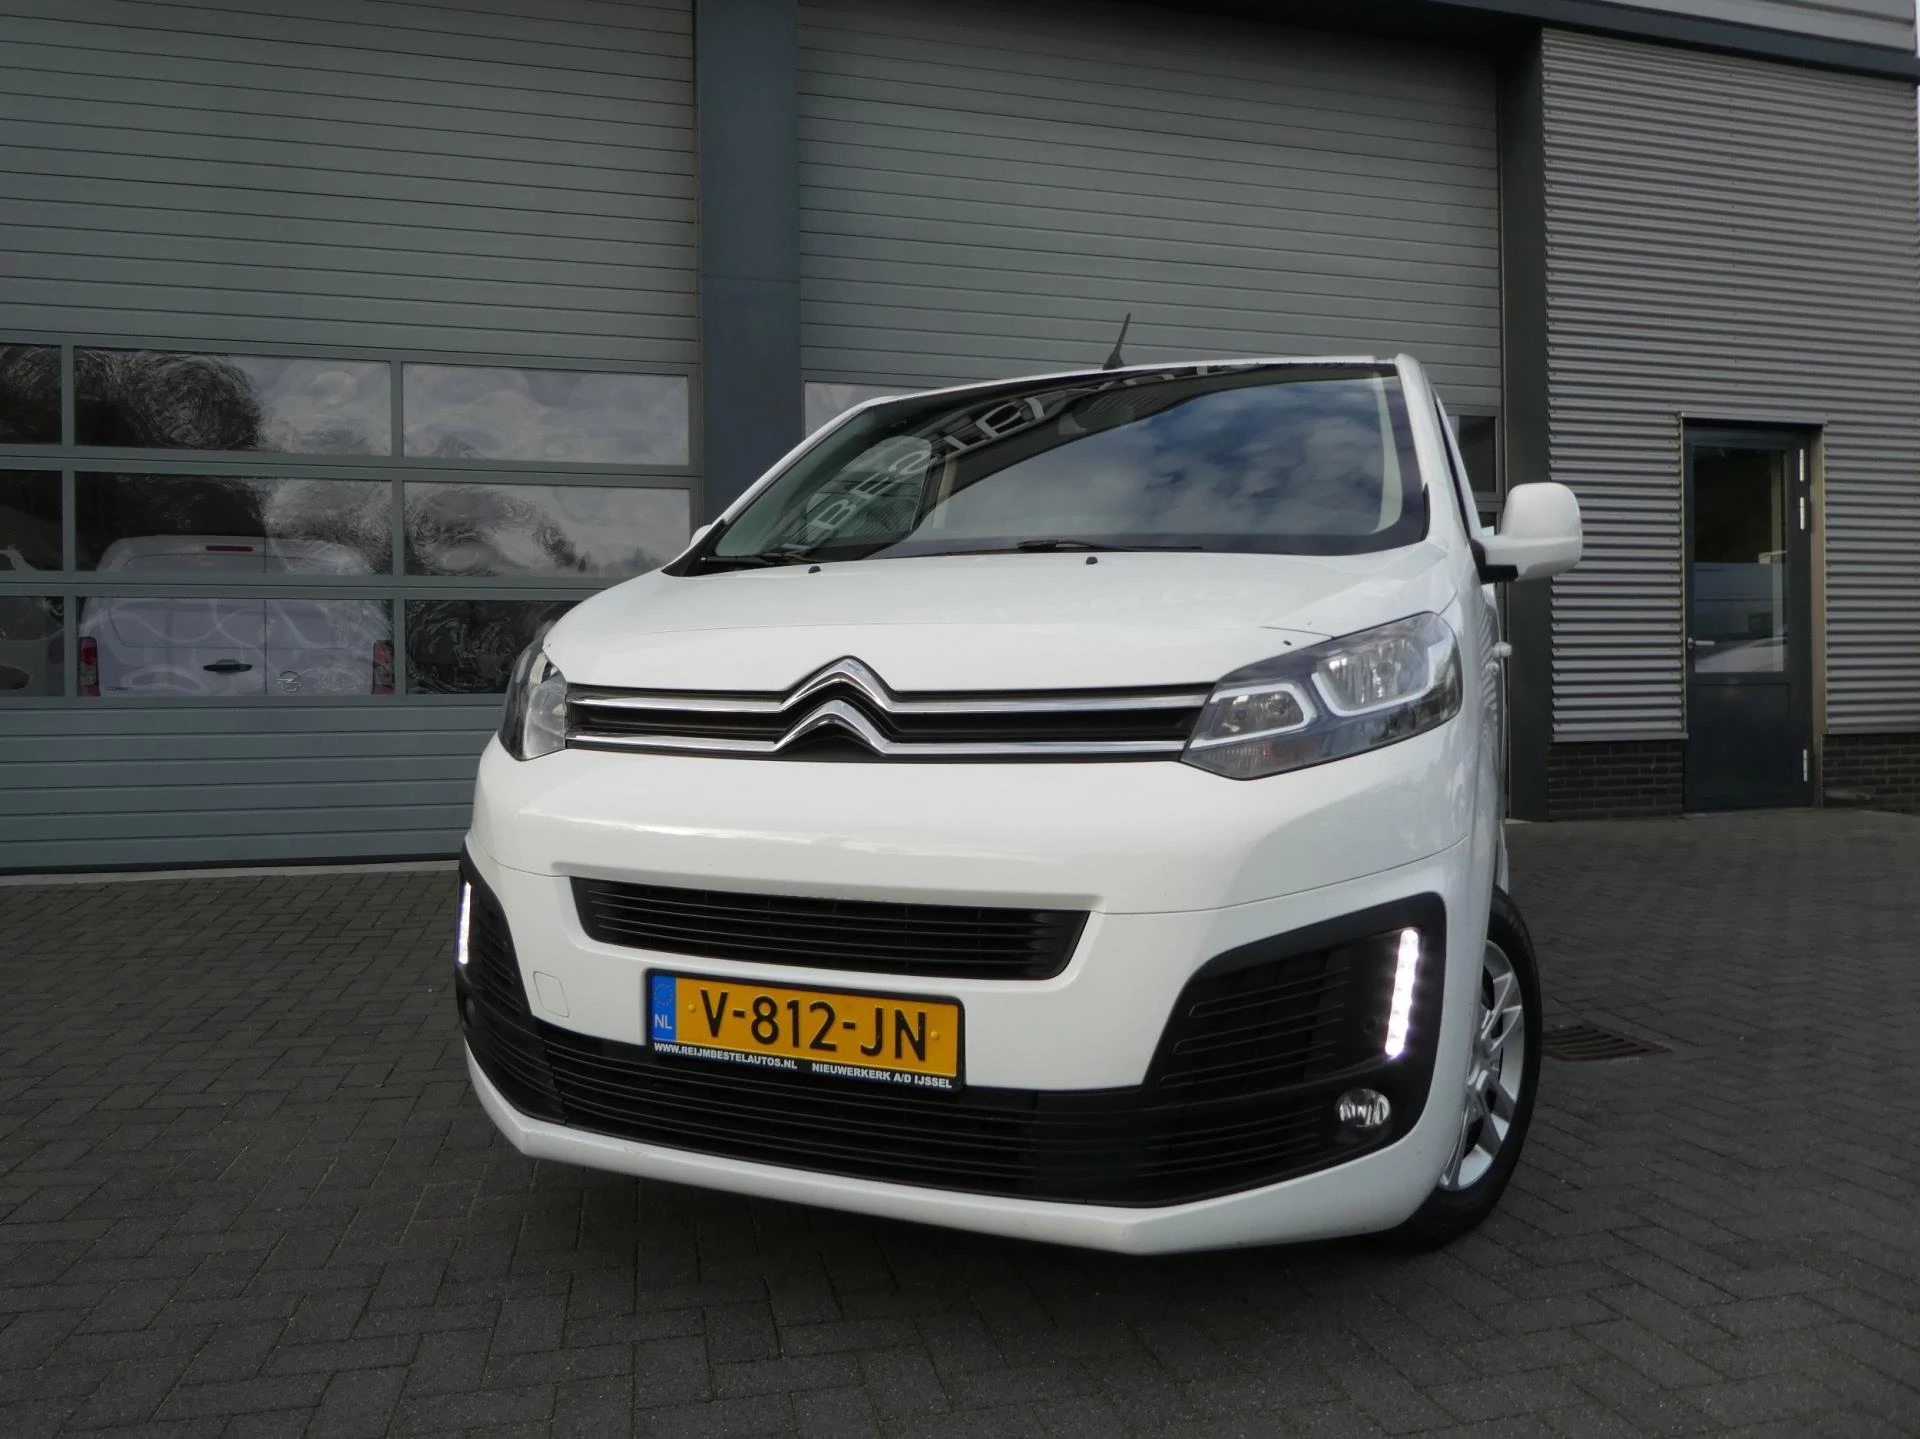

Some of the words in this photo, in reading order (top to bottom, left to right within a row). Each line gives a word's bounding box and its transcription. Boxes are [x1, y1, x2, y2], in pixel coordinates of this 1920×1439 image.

[654, 1013, 673, 1030] NL
[700, 988, 926, 1062] V-812-JN
[654, 1042, 798, 1069] WWW.REIJMBESTELAUTOS.NL
[812, 1062, 891, 1081] NIEUWERKERK
[893, 1073, 912, 1083] A/D
[914, 1075, 952, 1088] IJSSEL
